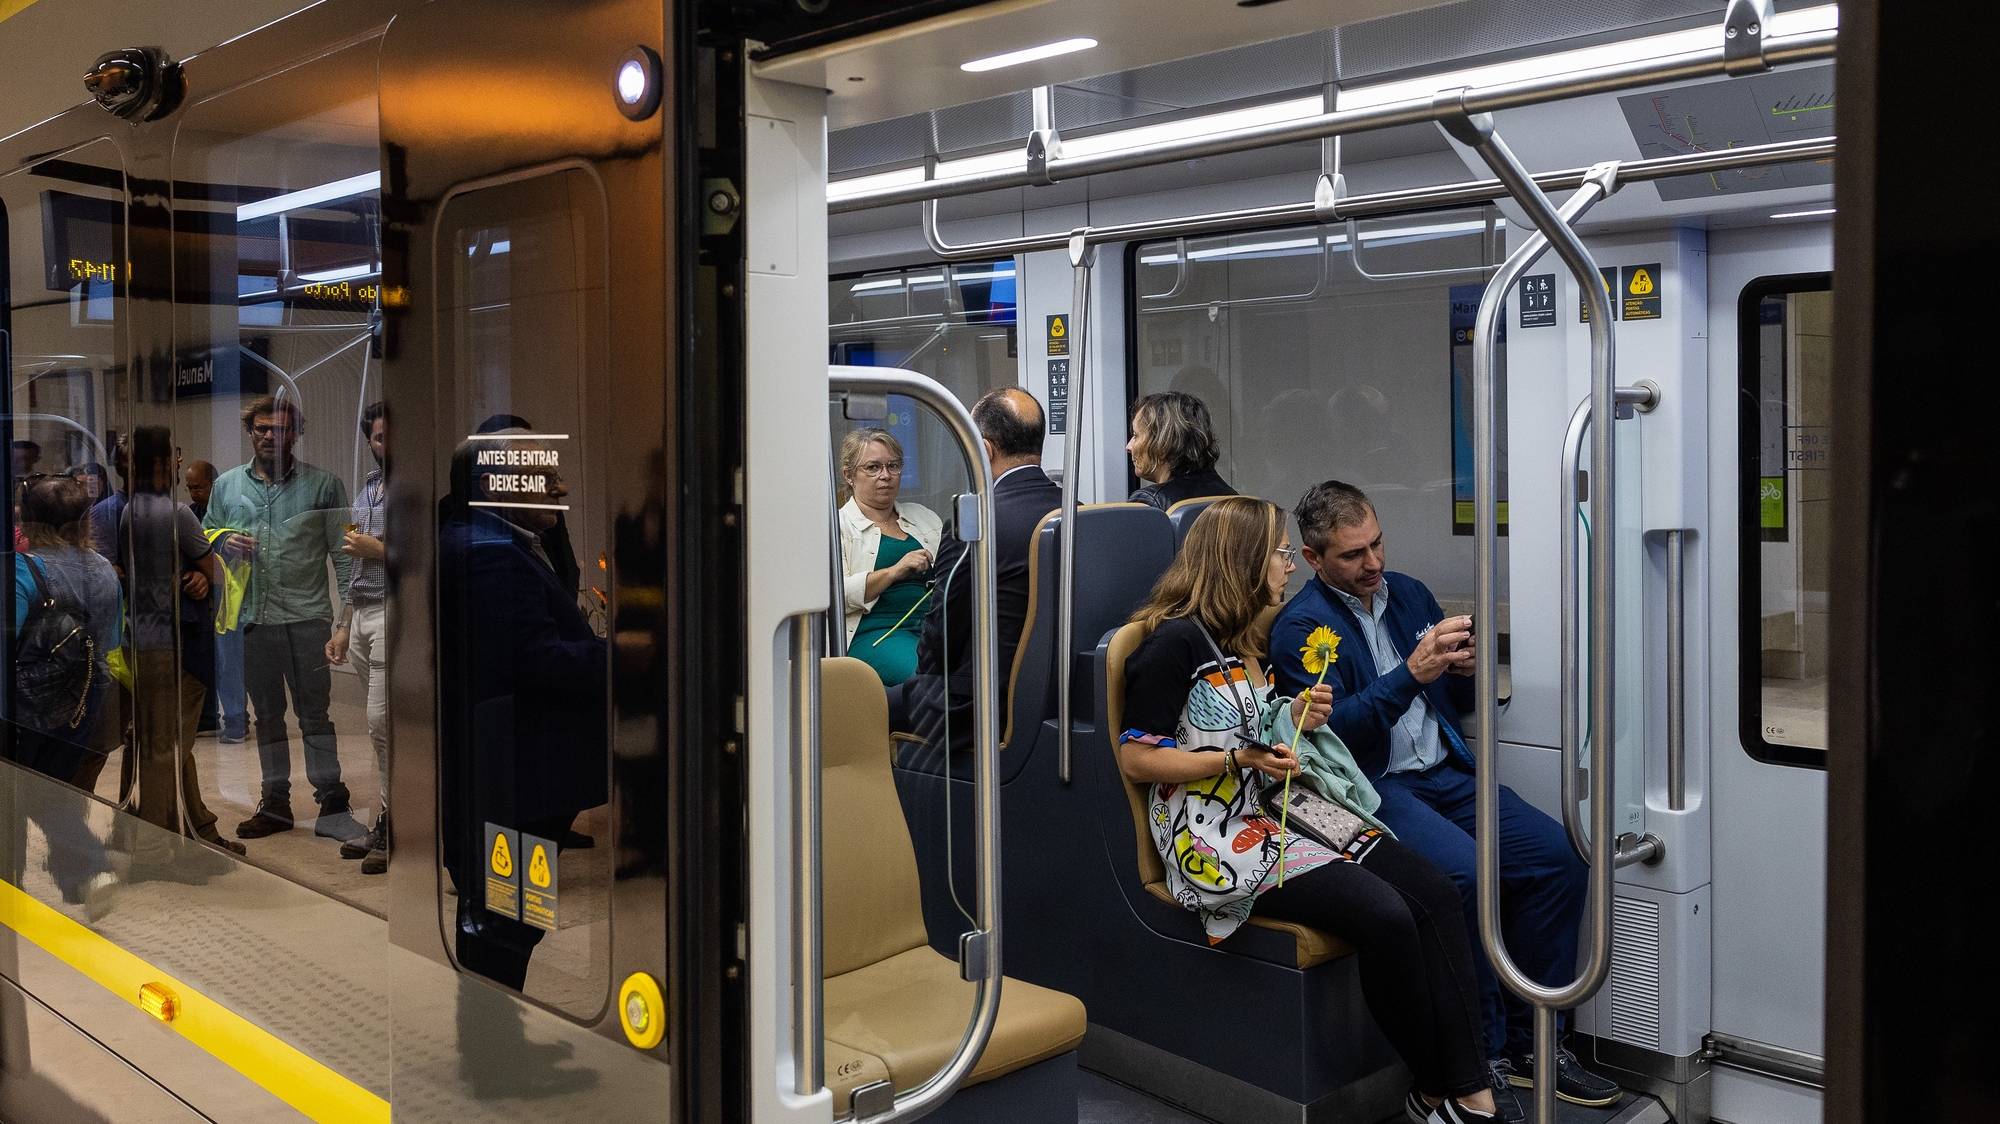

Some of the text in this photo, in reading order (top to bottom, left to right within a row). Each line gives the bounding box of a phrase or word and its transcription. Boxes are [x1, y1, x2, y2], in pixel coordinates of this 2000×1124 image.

[477, 450, 559, 466] ANTES DE ENTRAR
[489, 474, 546, 493] DEIXE SAIR
